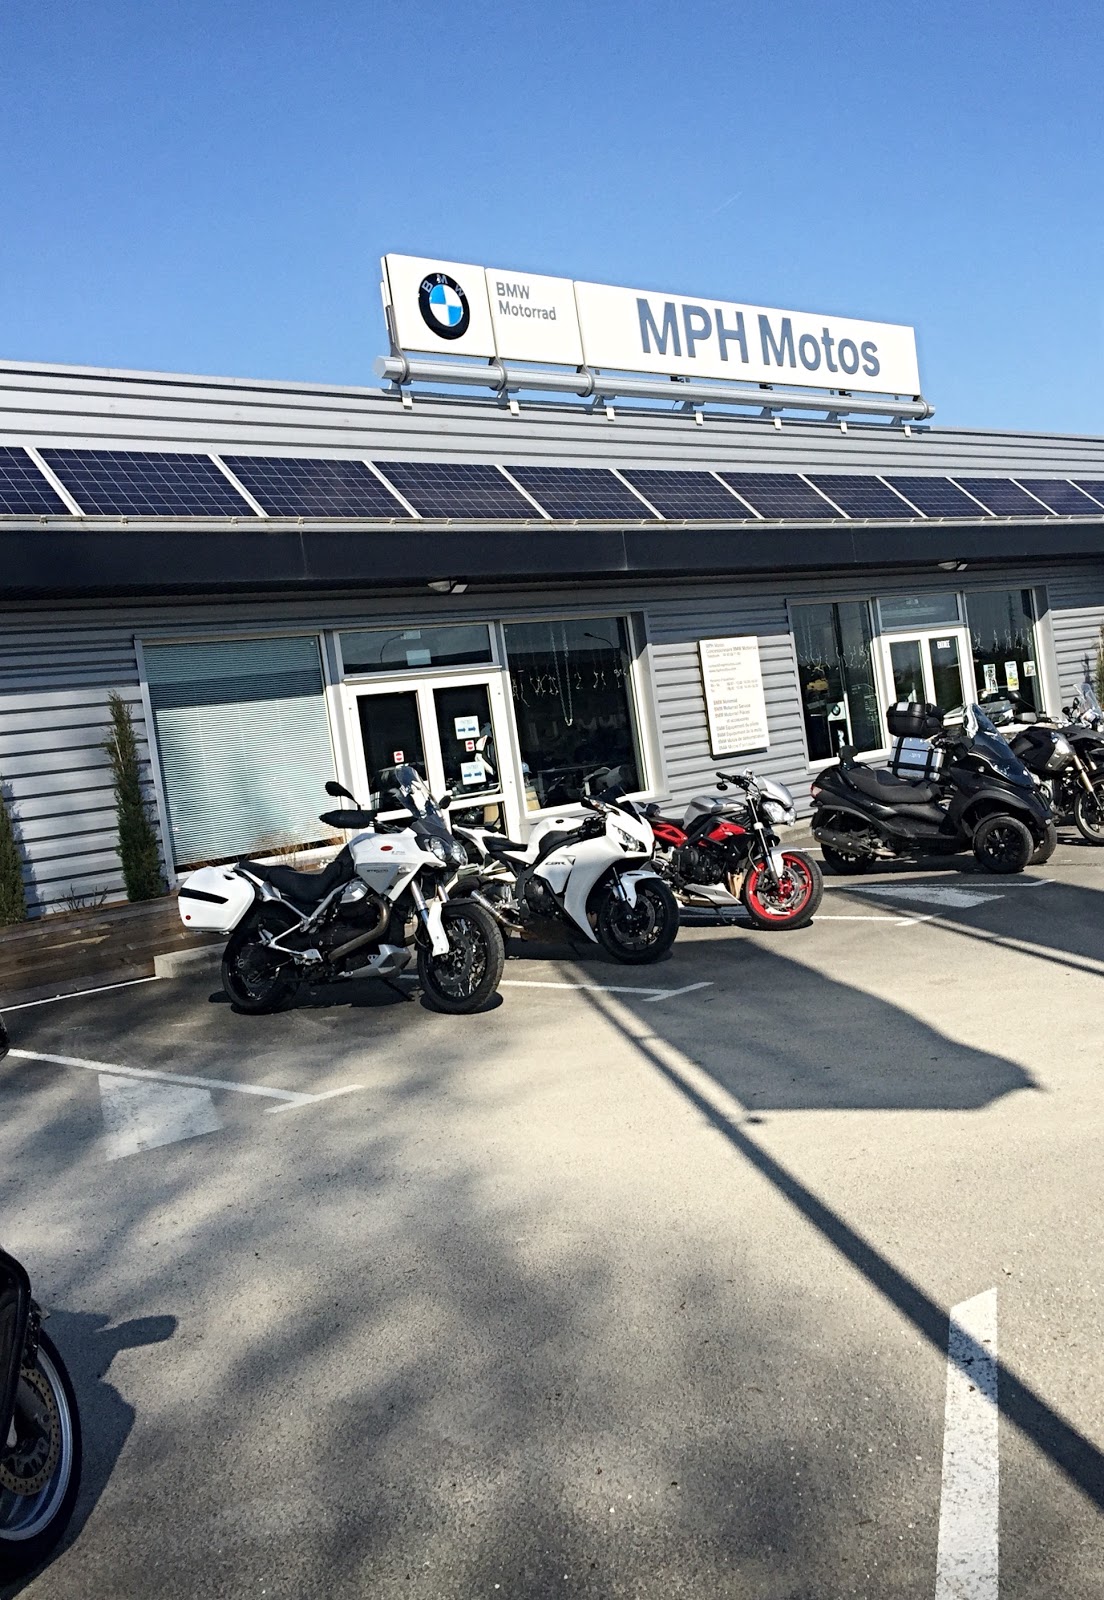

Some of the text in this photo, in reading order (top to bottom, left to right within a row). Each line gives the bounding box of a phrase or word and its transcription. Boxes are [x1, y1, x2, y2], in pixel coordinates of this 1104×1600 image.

[496, 281, 530, 300] BMW
[498, 300, 557, 321] Motorrad
[636, 297, 881, 377] MPH Motos
